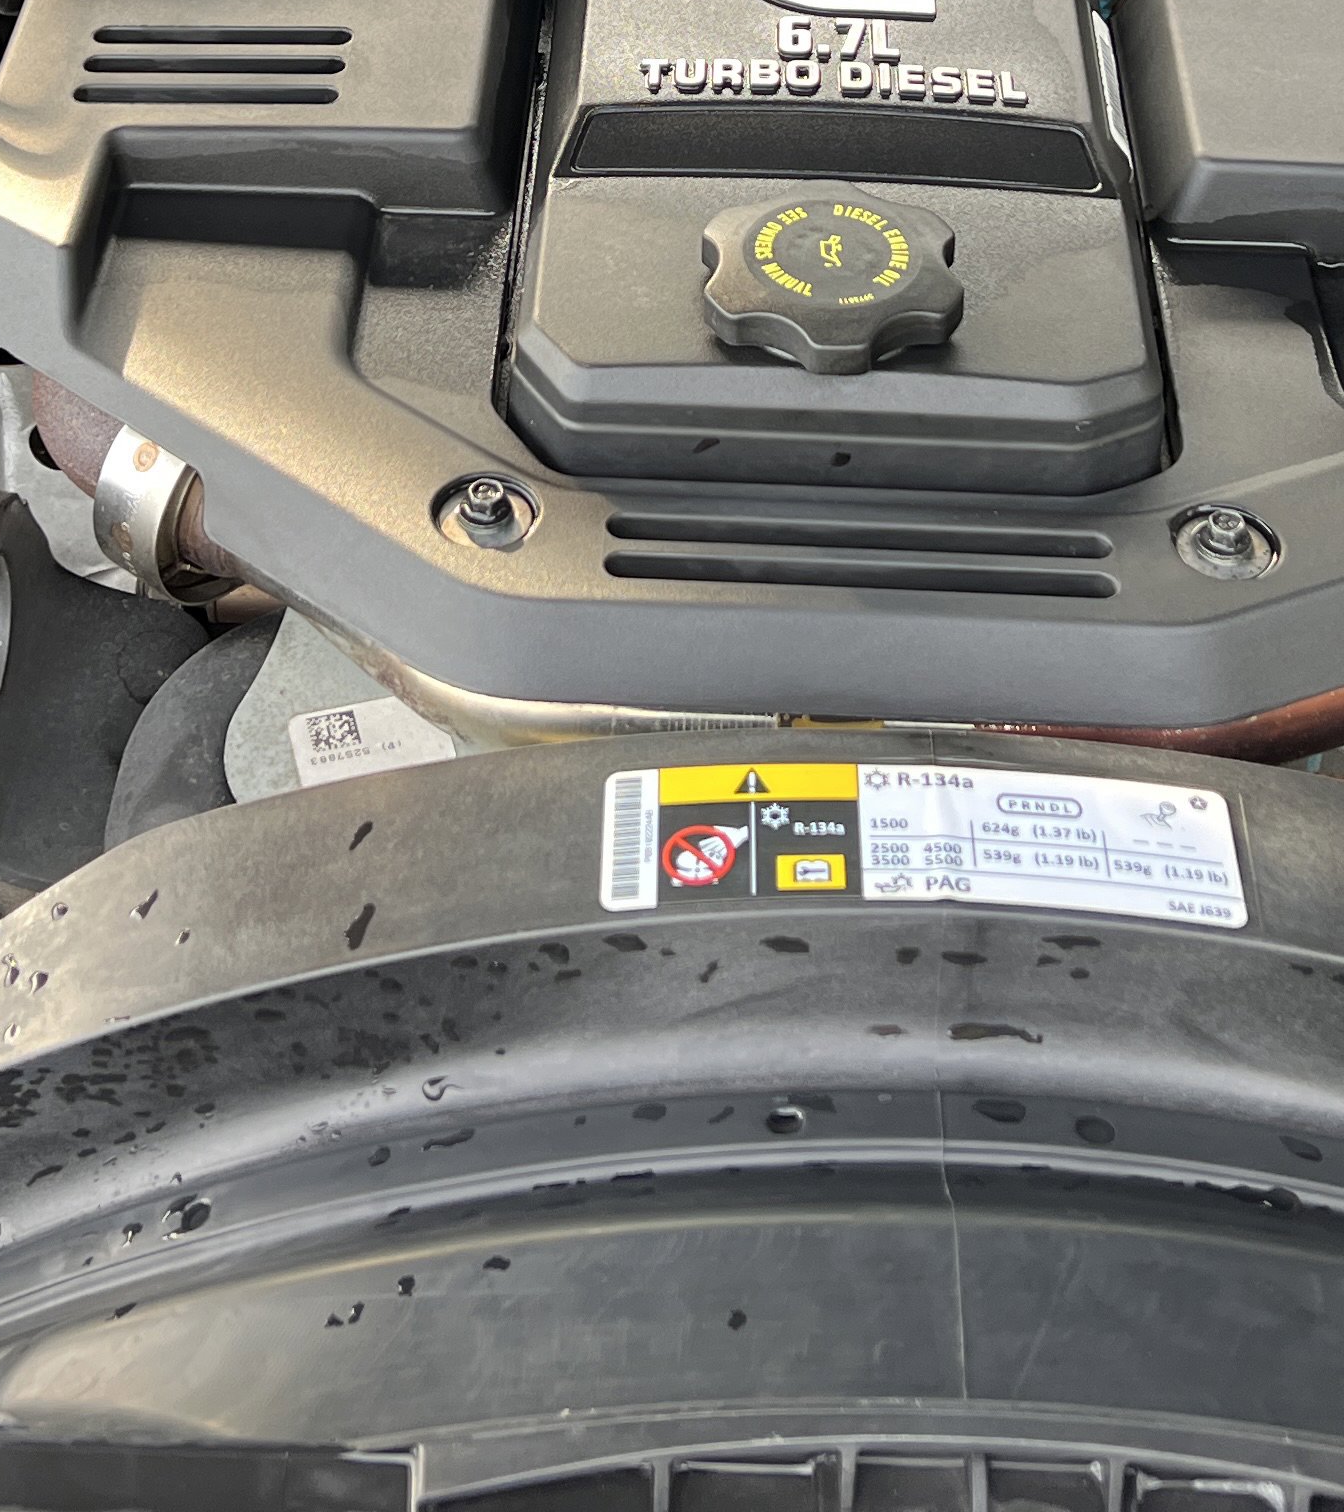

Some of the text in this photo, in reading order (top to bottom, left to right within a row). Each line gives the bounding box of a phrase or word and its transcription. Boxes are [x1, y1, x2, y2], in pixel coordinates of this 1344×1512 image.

[776, 15, 901, 64] 6.7L
[640, 57, 1030, 107] TURBO DIESEL
[777, 206, 808, 226] SEE
[833, 203, 910, 287] DIESEL ENGINE OIL
[897, 771, 974, 789] R-134a
[793, 821, 846, 836] R-134a
[870, 817, 909, 829] 1500
[981, 821, 1097, 843] 624g (1.37 lb)
[870, 842, 962, 855] 2500 4500
[871, 854, 964, 867] 3500 5500
[983, 848, 1100, 871] 539g (1.19 lb)
[1113, 859, 1229, 887] 539g (1.19 lb)
[925, 874, 972, 893] PAG
[1169, 900, 1232, 919] SAE J639
